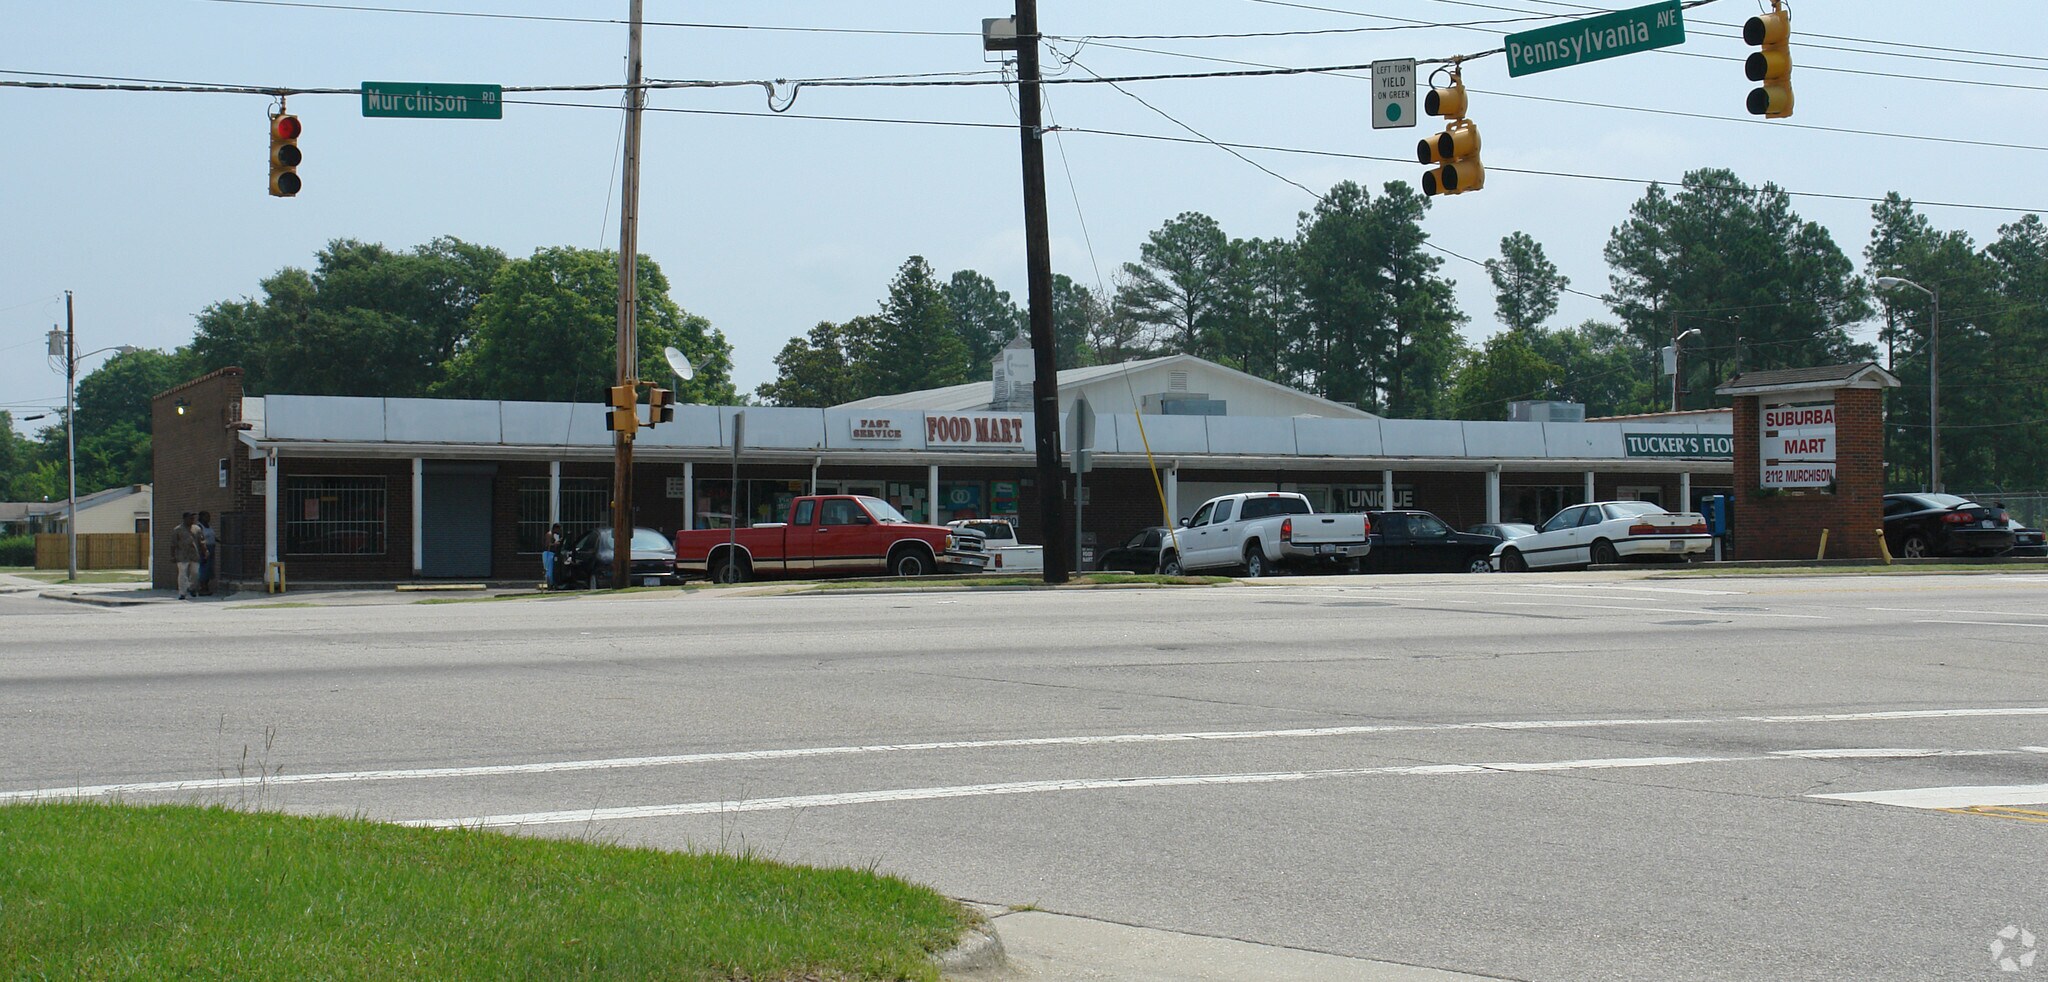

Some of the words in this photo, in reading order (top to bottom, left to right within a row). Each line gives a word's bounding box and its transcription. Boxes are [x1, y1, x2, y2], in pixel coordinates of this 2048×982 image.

[1510, 19, 1649, 68] Pennsylvania
[1656, 9, 1677, 29] AVE
[1376, 65, 1391, 75] LEFT
[1394, 64, 1411, 73] TURN
[1382, 76, 1406, 88] YIELD
[368, 88, 467, 112] Murchison
[482, 91, 496, 105] RD
[1378, 91, 1387, 100] ON
[1389, 90, 1410, 99] GREEN
[860, 419, 891, 428] FAST
[1766, 409, 1836, 427] SUBURBA
[852, 429, 902, 438] SERVICE
[926, 415, 972, 442] FOOD
[974, 417, 1023, 443] MART
[1627, 436, 1699, 453] TUCKER'S
[1784, 438, 1826, 454] MART
[1765, 470, 1784, 483] 2112
[1785, 469, 1833, 482] MURCHISON
